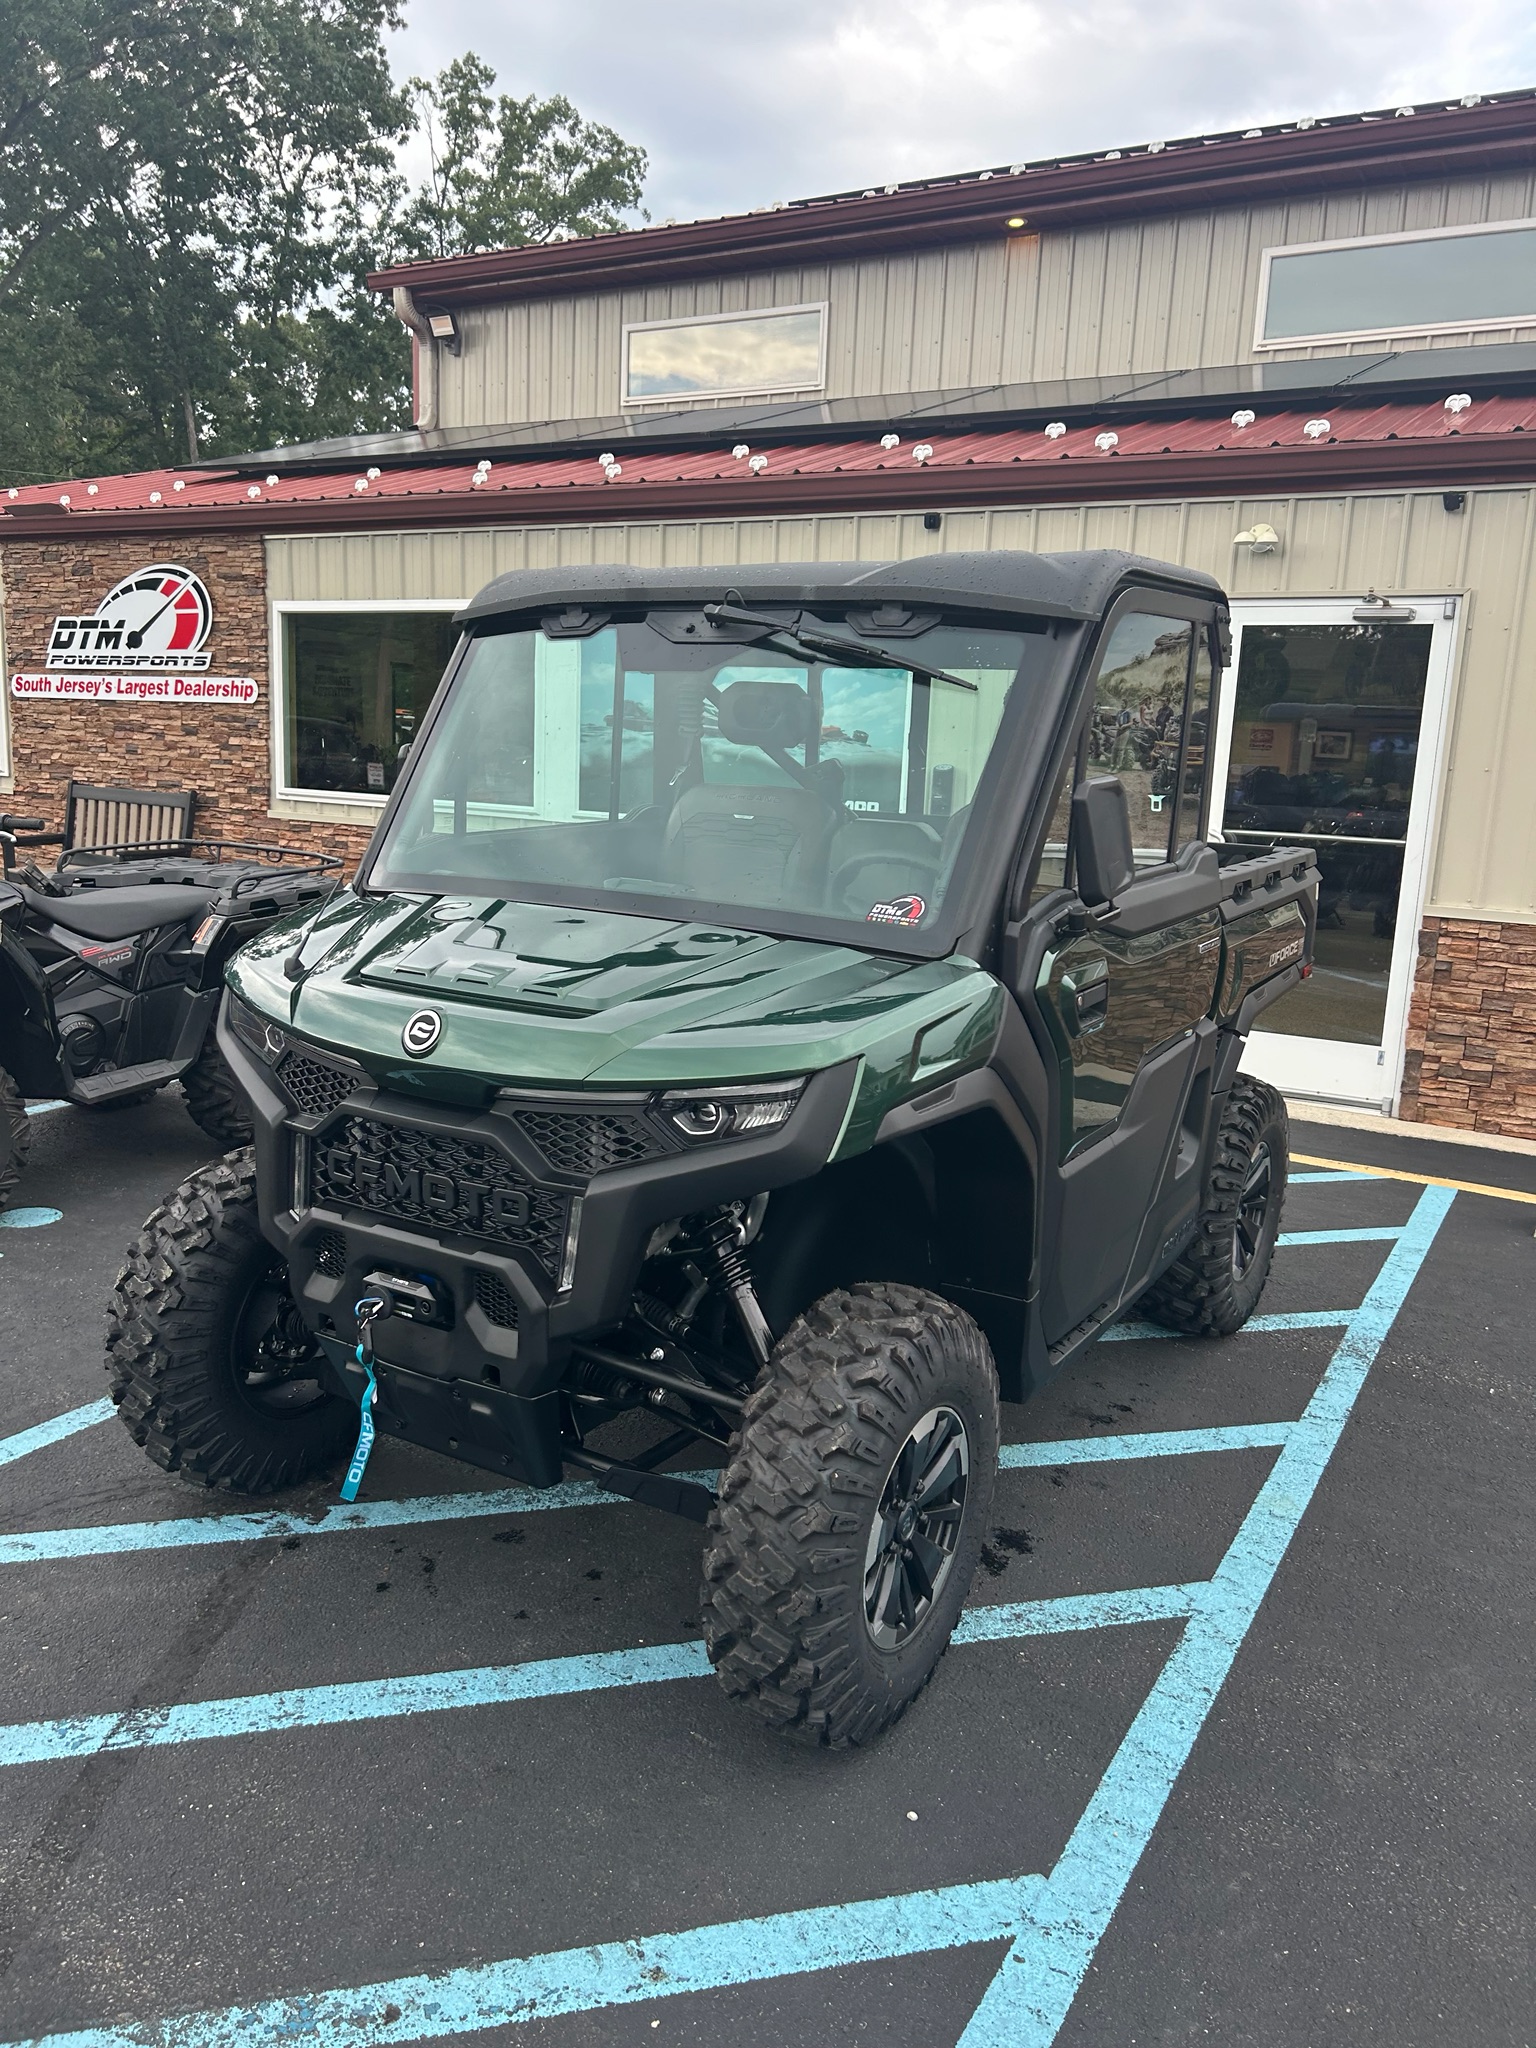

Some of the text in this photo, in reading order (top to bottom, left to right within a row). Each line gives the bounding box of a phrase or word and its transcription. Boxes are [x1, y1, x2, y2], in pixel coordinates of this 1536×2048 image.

[50, 619, 126, 650] DTM
[49, 654, 208, 667] POWERSPORTS
[14, 676, 255, 701] South Jersey's Largest Dealership
[871, 904, 899, 916] DTM
[97, 951, 132, 967] AWD
[327, 1148, 530, 1227] CFMOTO
[349, 1411, 373, 1483] CFMOTO
